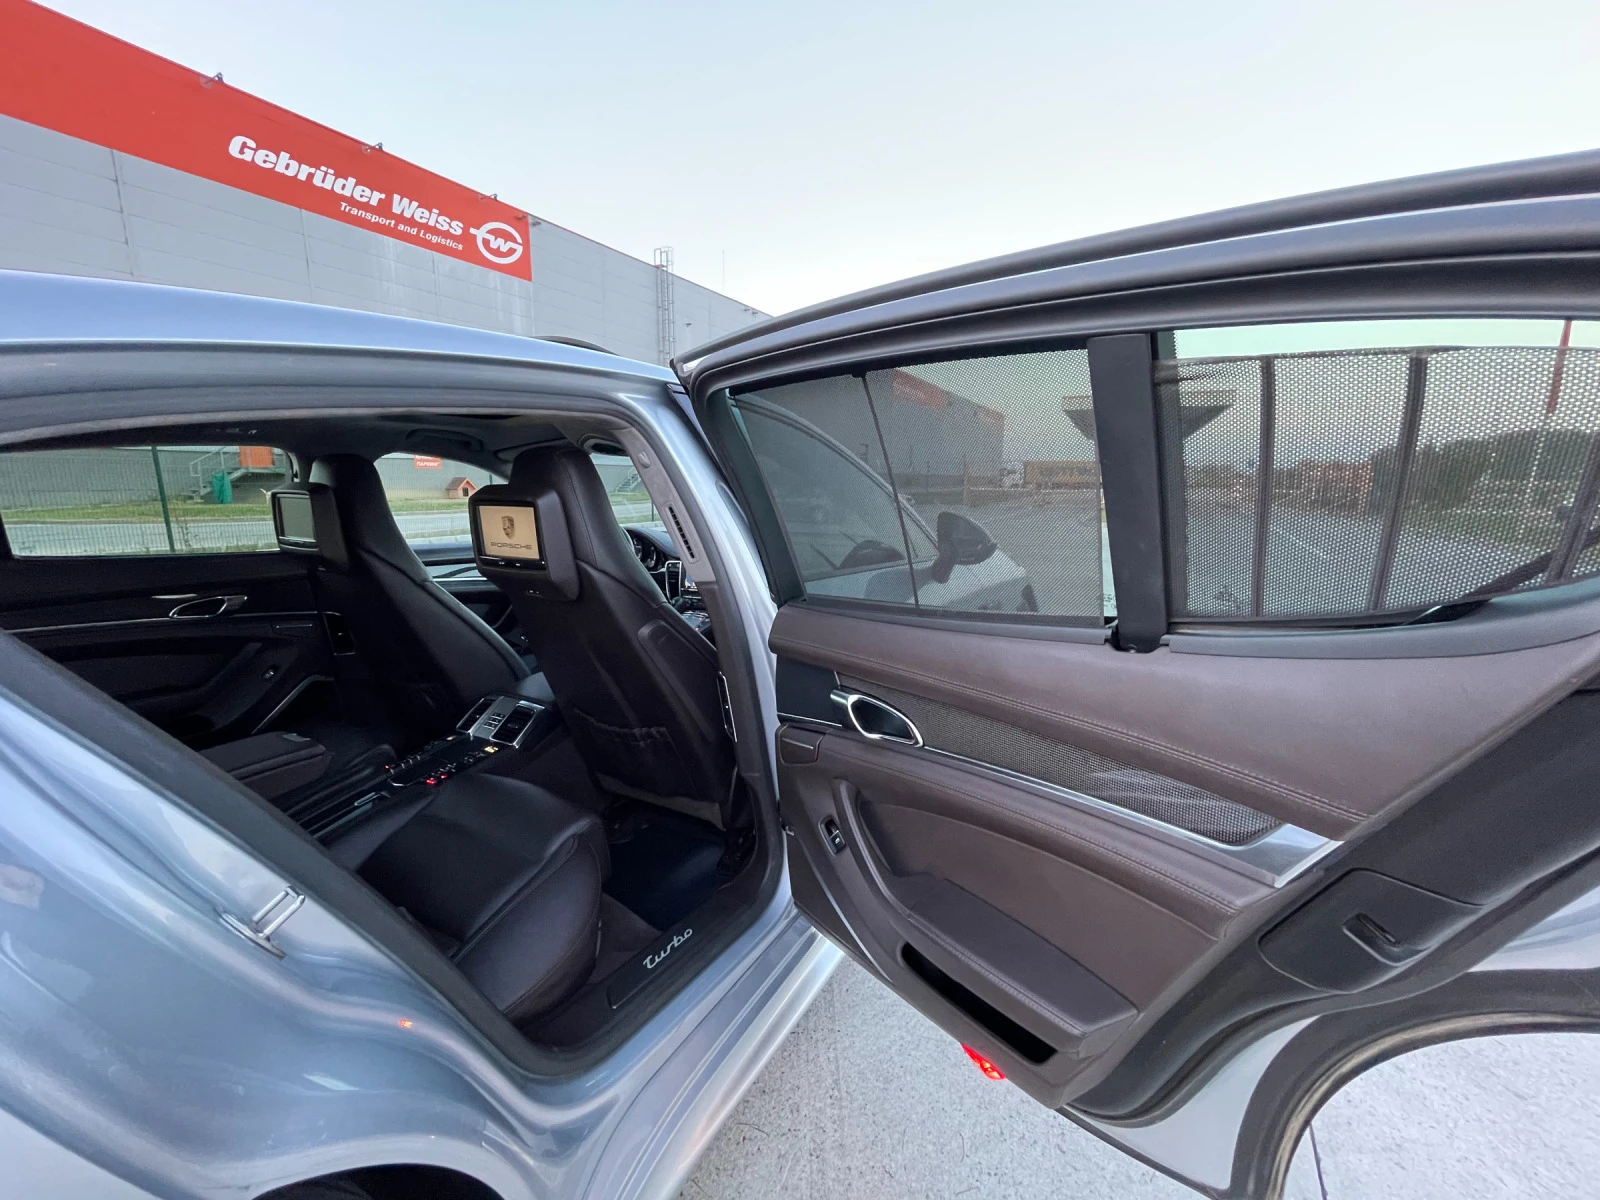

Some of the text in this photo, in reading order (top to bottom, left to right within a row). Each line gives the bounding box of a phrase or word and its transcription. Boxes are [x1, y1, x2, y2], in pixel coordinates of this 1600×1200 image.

[229, 135, 463, 236] Gebrüder Weiss
[340, 201, 463, 251] Transport and Logistics
[490, 541, 532, 550] PORSCHE
